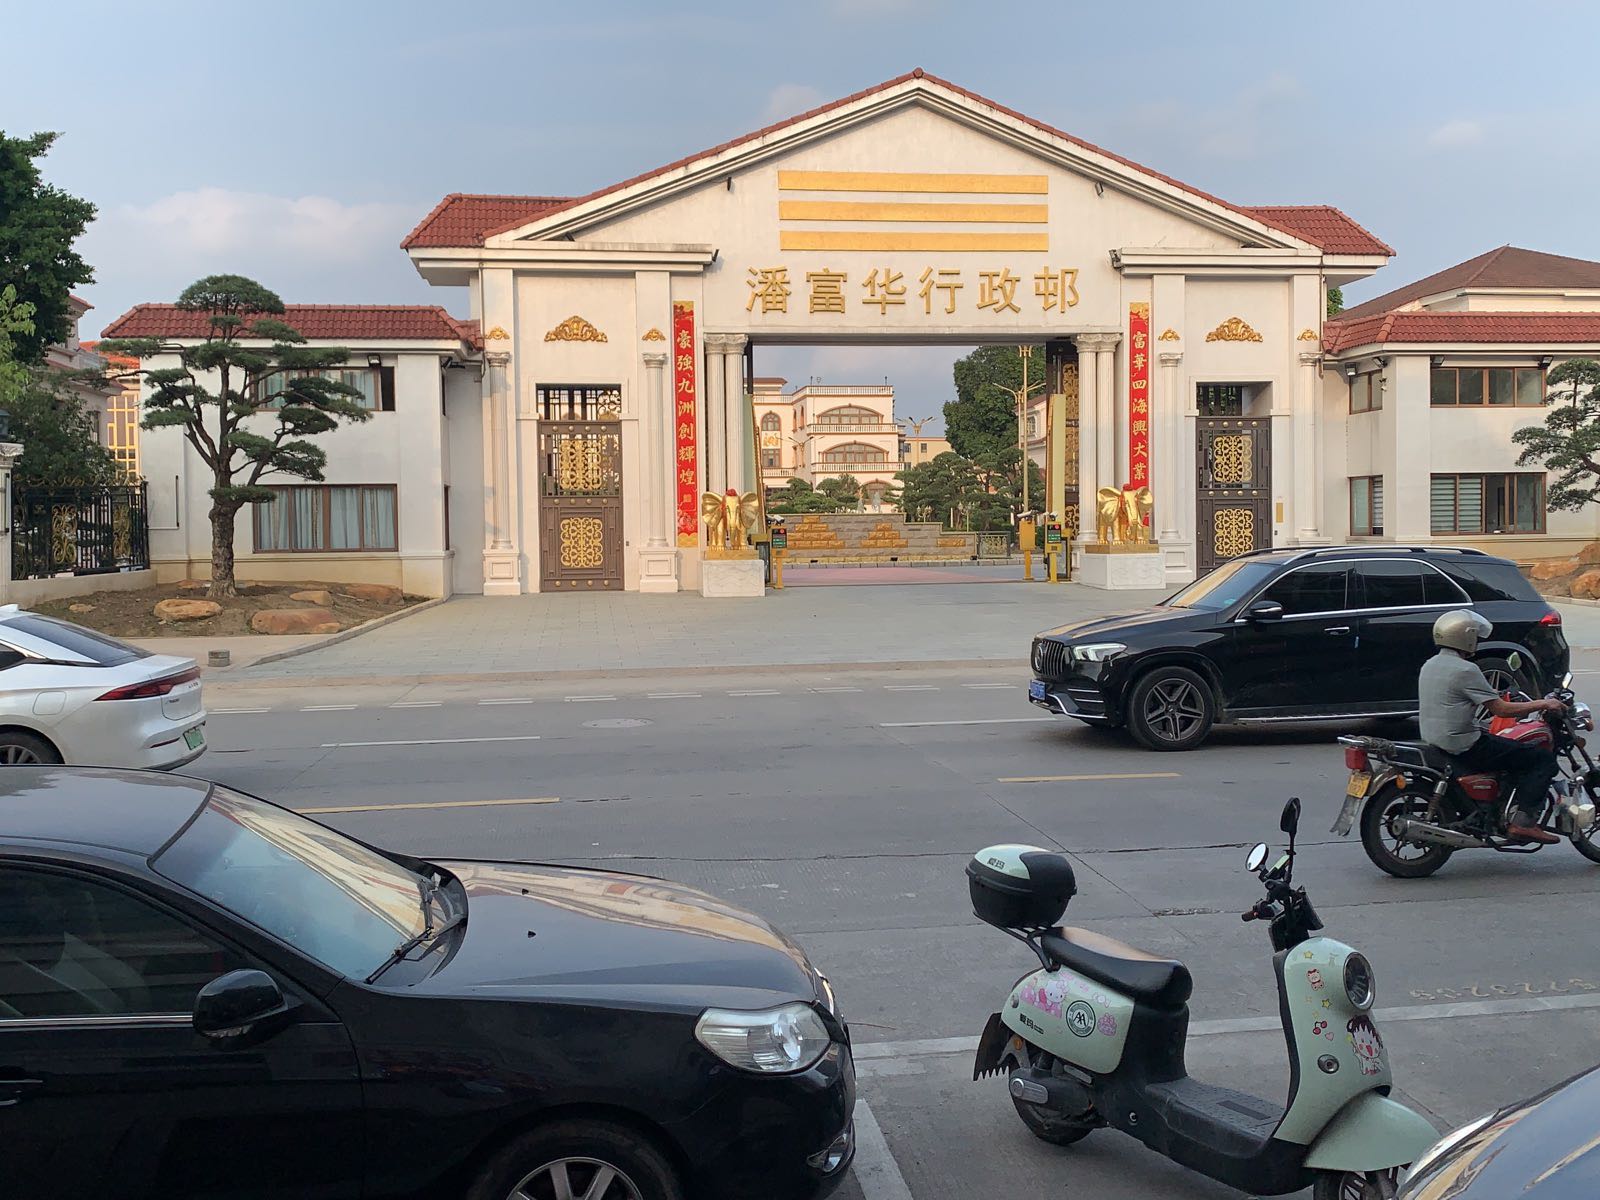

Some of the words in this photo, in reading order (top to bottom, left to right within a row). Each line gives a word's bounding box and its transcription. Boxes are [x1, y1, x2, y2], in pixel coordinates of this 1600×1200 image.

[746, 266, 1080, 314] 潘富华行政邨
